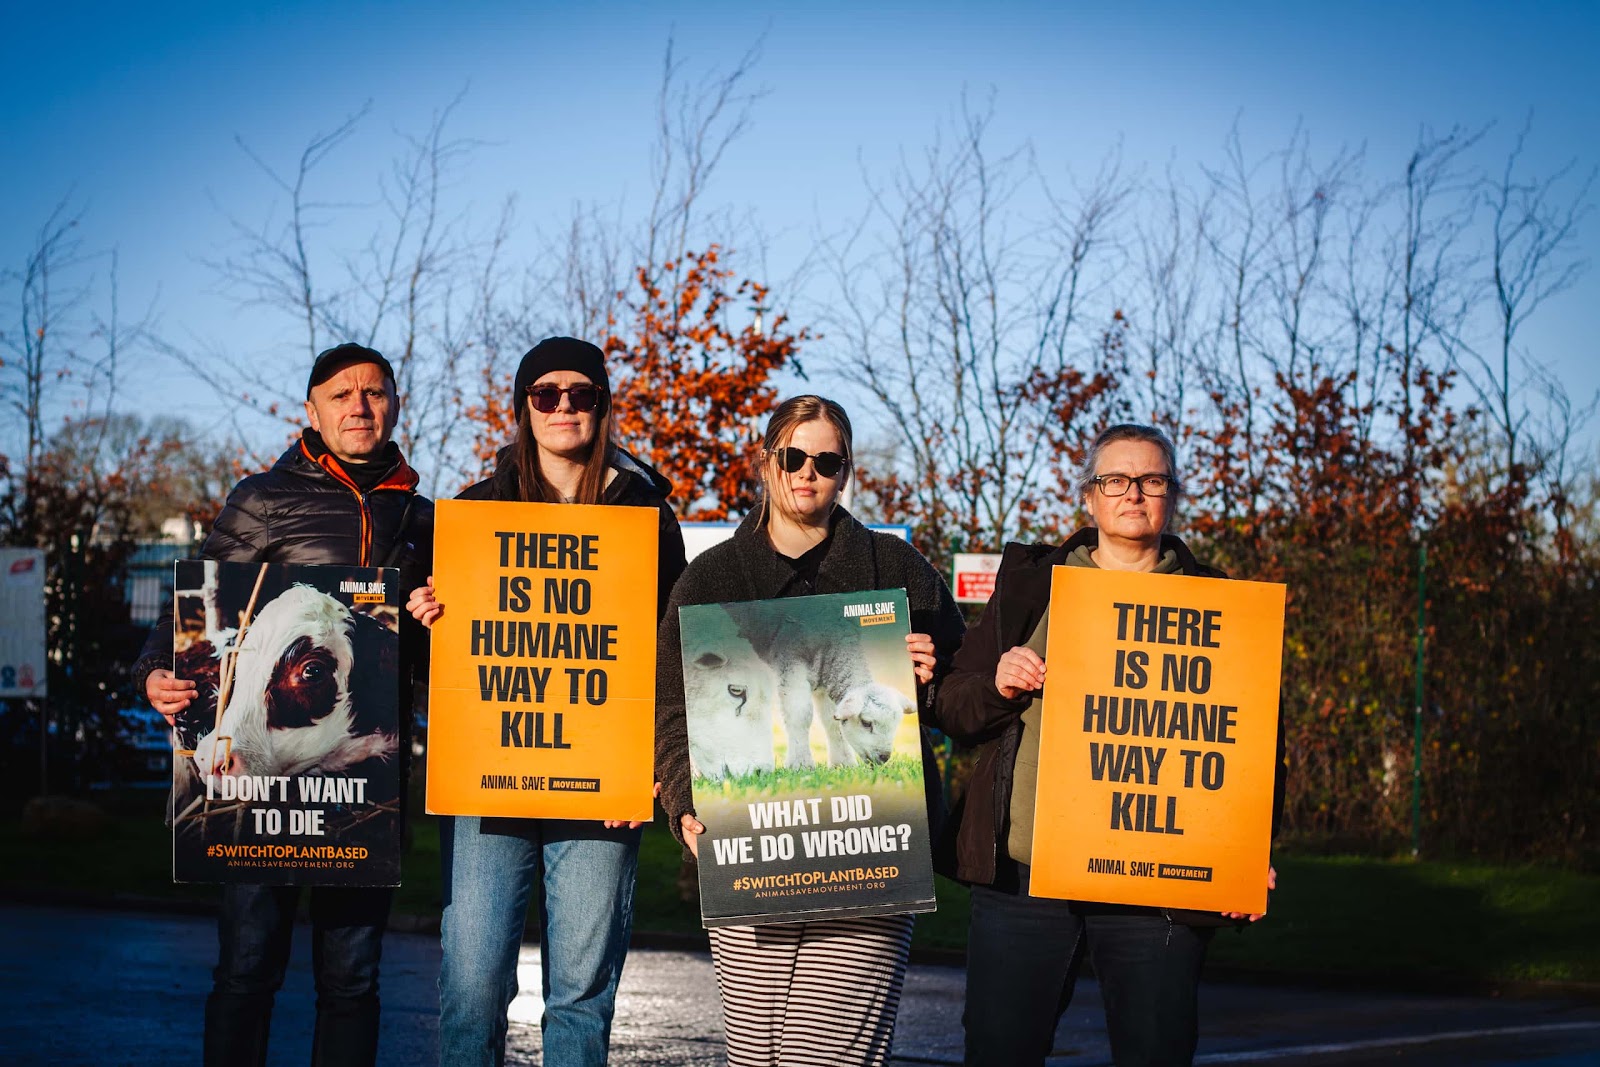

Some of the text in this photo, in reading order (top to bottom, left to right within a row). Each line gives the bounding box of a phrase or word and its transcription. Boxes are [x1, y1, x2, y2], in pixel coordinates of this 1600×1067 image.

[495, 532, 599, 571] THERE
[340, 581, 386, 594] ANIMAL SAVE
[498, 576, 591, 615] IS NO
[844, 602, 895, 617] ANIMAL SAVE
[1113, 602, 1222, 648] THERE
[471, 620, 618, 660] HUMANE
[478, 665, 608, 706] WAY TO
[1114, 650, 1212, 694] IS NO
[500, 711, 571, 750] KILL
[1083, 694, 1238, 744] HUMANE
[480, 775, 596, 791] ANIMAL SAVE MOVEMENT
[1090, 742, 1225, 790] WAY TO
[206, 775, 368, 804] I DON'T WANT
[252, 809, 324, 836] TO DIE
[748, 794, 872, 829] WHAT DID
[1110, 792, 1184, 835] KILL
[206, 844, 368, 860] #SWITCHTOPLANTBASED
[712, 824, 912, 865] WE DO WRONG?
[228, 860, 354, 869] ANIMALSAVEMOVEMENT.ORG
[733, 866, 899, 891] #SWITCHTOPLANTBASED
[1087, 858, 1208, 879] ANIMAL SAVE MOVEMENT
[755, 882, 886, 898] ANIMALSAVEMOVEMENT.ORG
